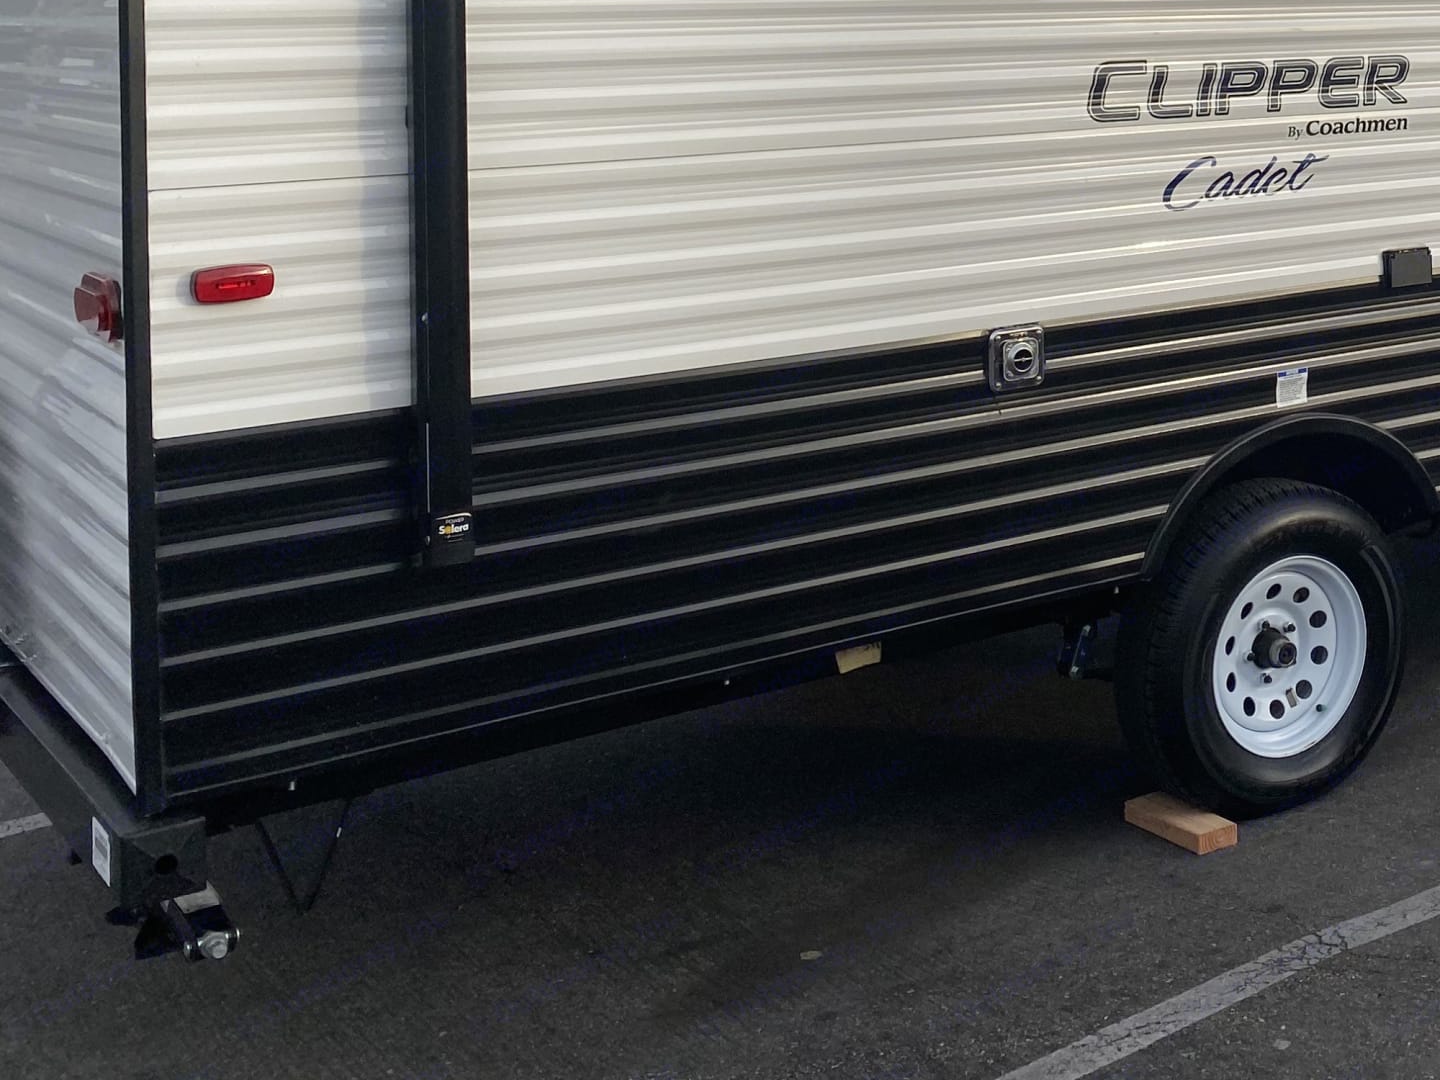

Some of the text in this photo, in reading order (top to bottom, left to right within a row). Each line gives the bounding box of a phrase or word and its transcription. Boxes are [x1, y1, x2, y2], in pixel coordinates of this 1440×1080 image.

[1087, 54, 1410, 123] CLIPPER
[1288, 117, 1408, 140] By Coachmen
[1162, 153, 1330, 211] Cadet
[438, 523, 469, 535] Solera
